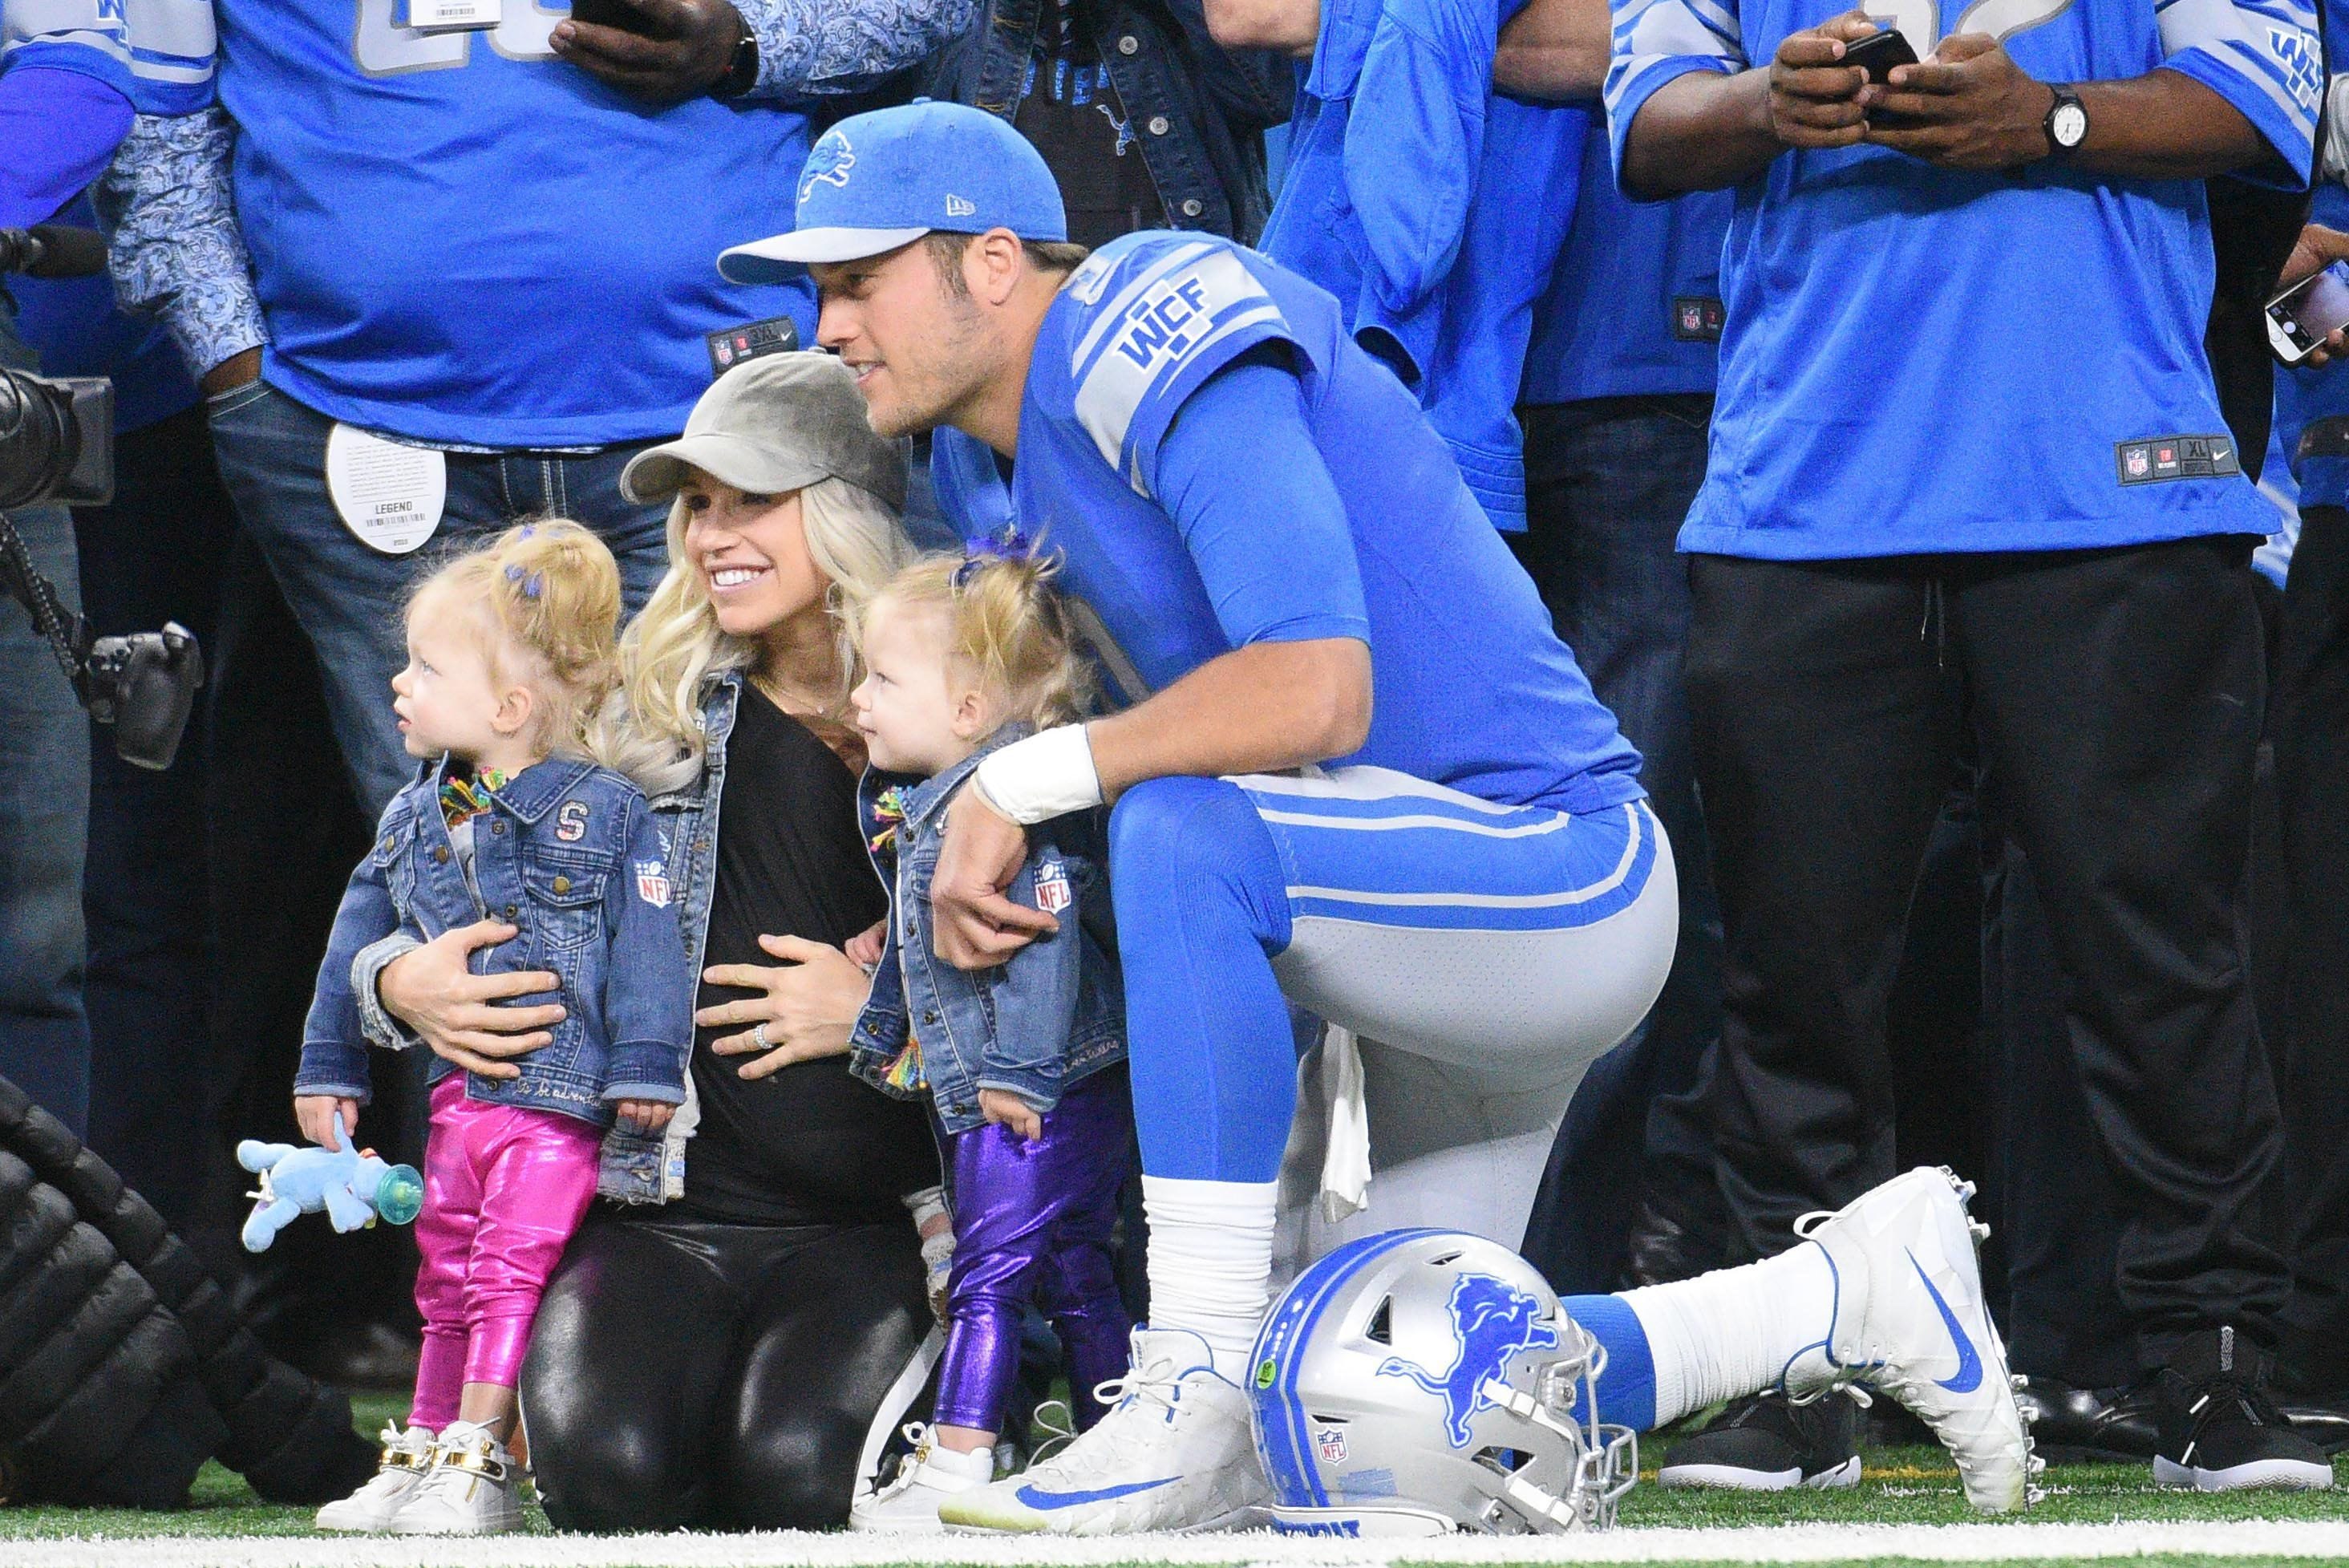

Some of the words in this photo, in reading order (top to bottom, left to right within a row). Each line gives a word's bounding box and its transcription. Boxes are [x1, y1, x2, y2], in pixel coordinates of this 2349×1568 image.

[1116, 275, 1208, 371] WCF
[2189, 440, 2205, 457] XL
[2131, 460, 2144, 471] NFL
[375, 501, 412, 515] LEGEND
[556, 800, 589, 842] S
[1038, 882, 1070, 910] NFL
[1323, 1443, 1345, 1459] NFL
